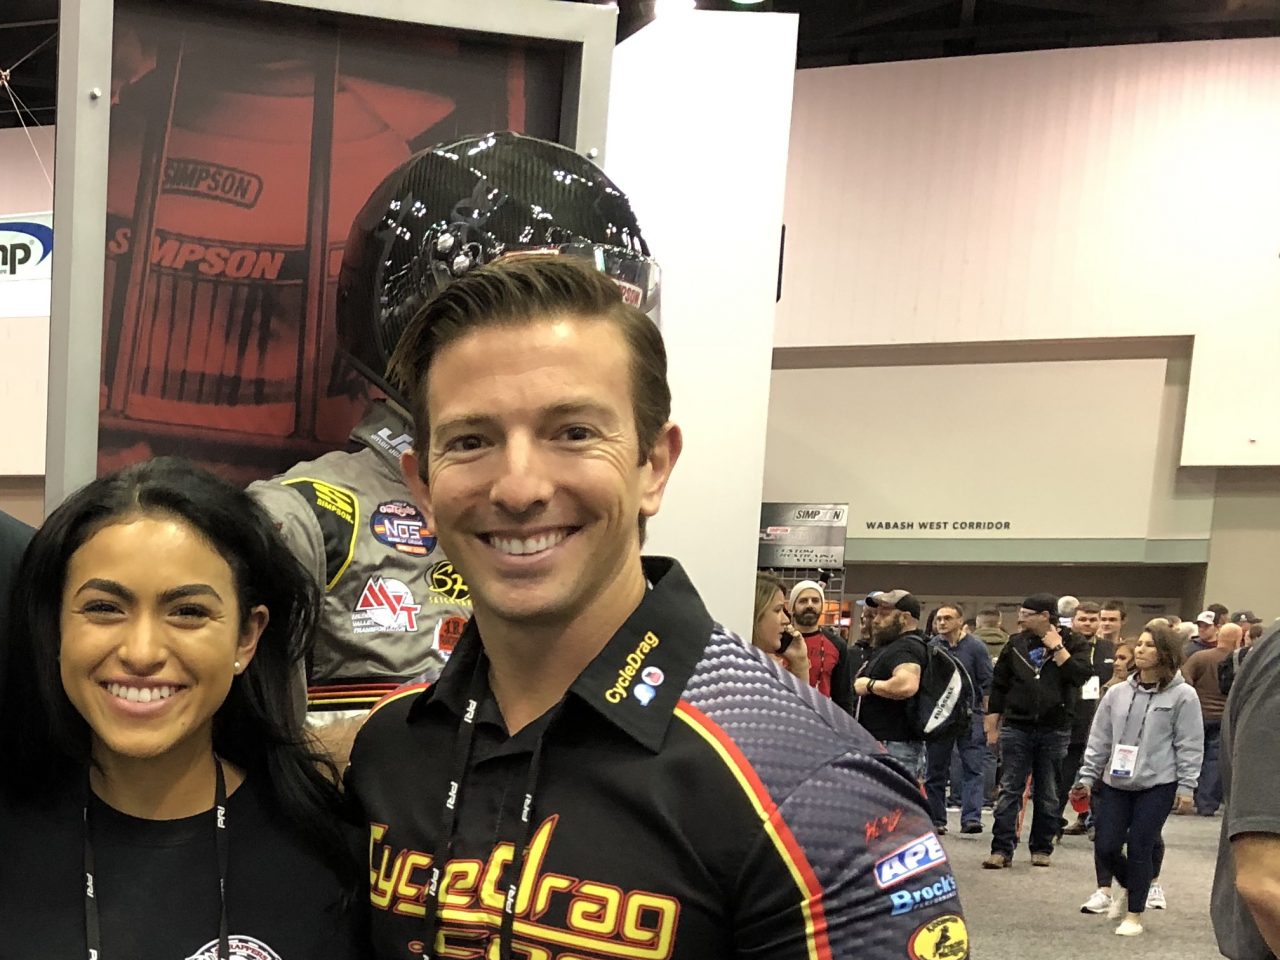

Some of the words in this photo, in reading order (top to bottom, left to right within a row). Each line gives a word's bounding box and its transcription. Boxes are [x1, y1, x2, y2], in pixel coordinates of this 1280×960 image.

[317, 498, 351, 522] SIMPSON
[796, 510, 841, 520] SIMPN
[866, 521, 914, 530] WABASH
[918, 521, 949, 530] WEST
[952, 521, 1011, 530] CORRIDOR
[605, 631, 660, 704] CycleDrag
[464, 699, 477, 723] PRI
[446, 781, 458, 809] PRI
[522, 794, 532, 822] PRI
[217, 805, 225, 829] PRI
[881, 835, 945, 883] APE
[86, 873, 94, 898] PRI
[429, 868, 439, 896] PRI
[890, 875, 957, 916] Brock's
[506, 884, 516, 914] PRI
